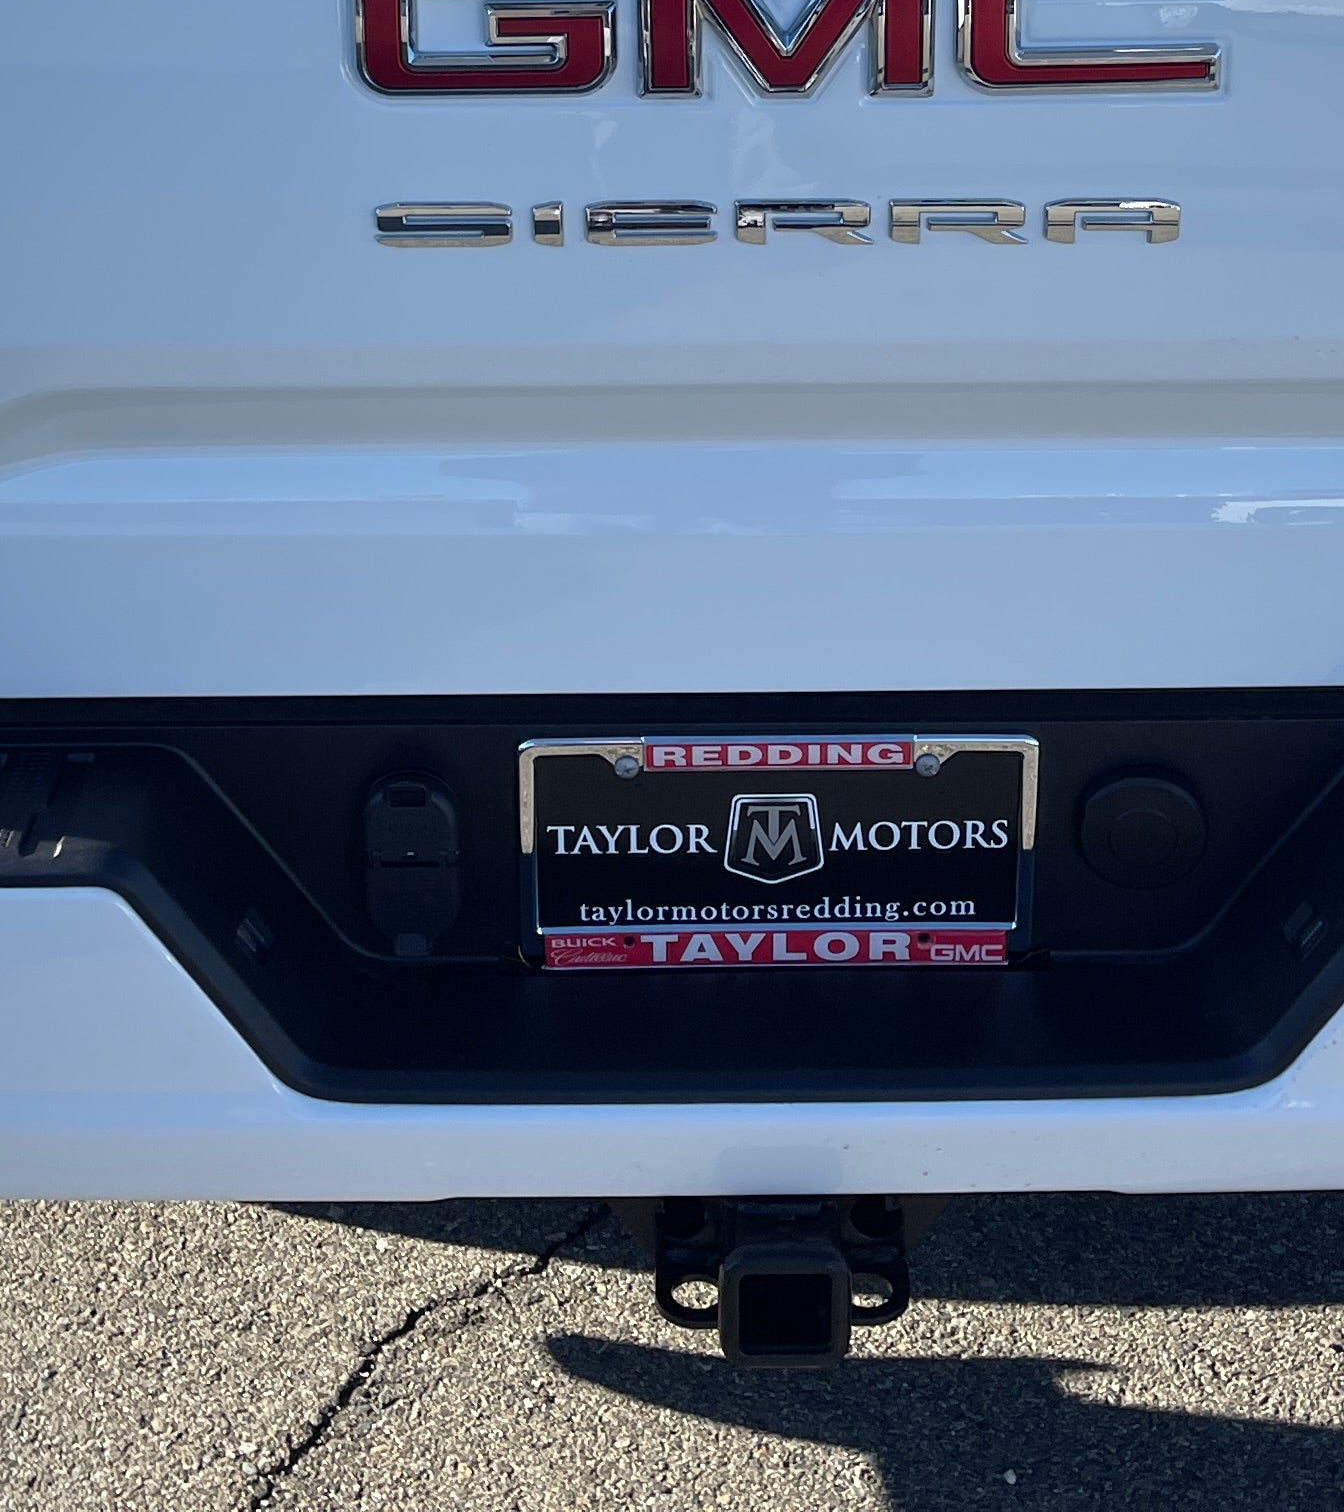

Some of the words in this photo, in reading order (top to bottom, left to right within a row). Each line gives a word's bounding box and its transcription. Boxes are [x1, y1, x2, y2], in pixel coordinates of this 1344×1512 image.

[374, 198, 1182, 247] SIERRA
[652, 743, 906, 767] REDDING
[546, 824, 718, 855] TAYLOR
[828, 818, 1010, 852] MOTORS
[579, 896, 977, 925] taylormotorsredding.com
[551, 936, 616, 949] BUICK
[640, 932, 912, 963] TAYLOR
[930, 944, 1004, 963] GMC
